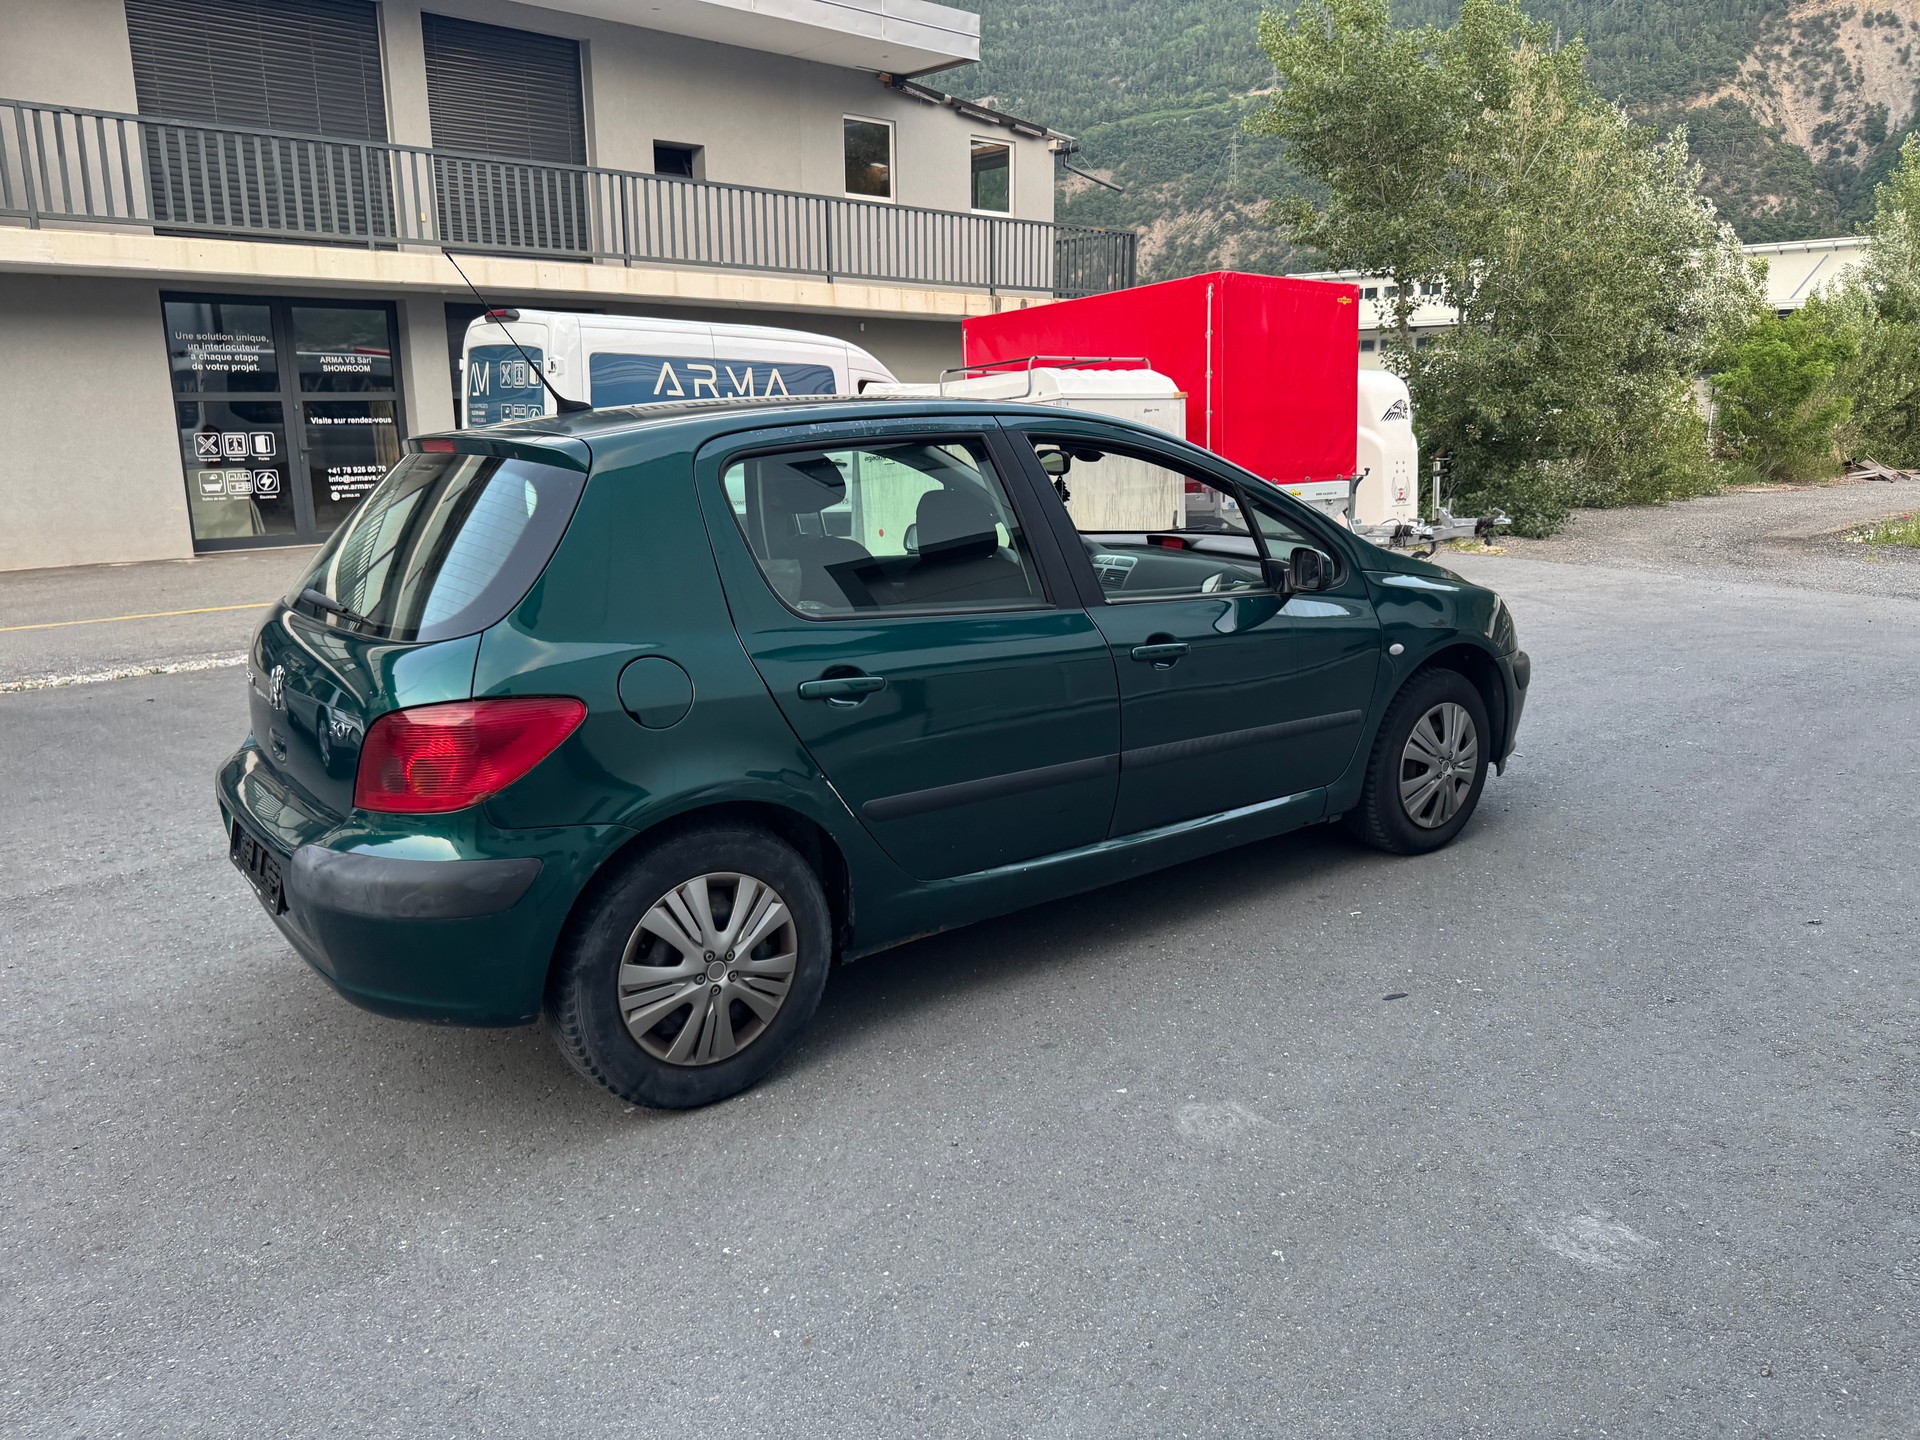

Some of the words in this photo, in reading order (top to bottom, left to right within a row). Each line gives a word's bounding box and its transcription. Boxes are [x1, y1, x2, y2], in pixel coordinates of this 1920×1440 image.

[175, 331, 194, 340] Une
[196, 332, 234, 341] solution
[236, 334, 269, 343] unique,
[187, 343, 200, 351] un
[202, 343, 260, 351] interlocuteur
[198, 352, 232, 362] chaque
[320, 356, 343, 364] ARMA
[344, 356, 356, 364] VS
[191, 362, 203, 371] de
[205, 363, 229, 371] votre
[231, 363, 260, 372] projet.
[322, 364, 371, 373] SHOWROOM
[653, 361, 790, 398] ARMA
[310, 416, 333, 425] Visite
[347, 416, 392, 424] rendez-vous
[327, 466, 341, 474] +41
[342, 466, 352, 474] 78
[367, 465, 377, 473] 00
[377, 465, 387, 473] 70
[330, 483, 375, 491] www.armav
[329, 720, 353, 741] 307
